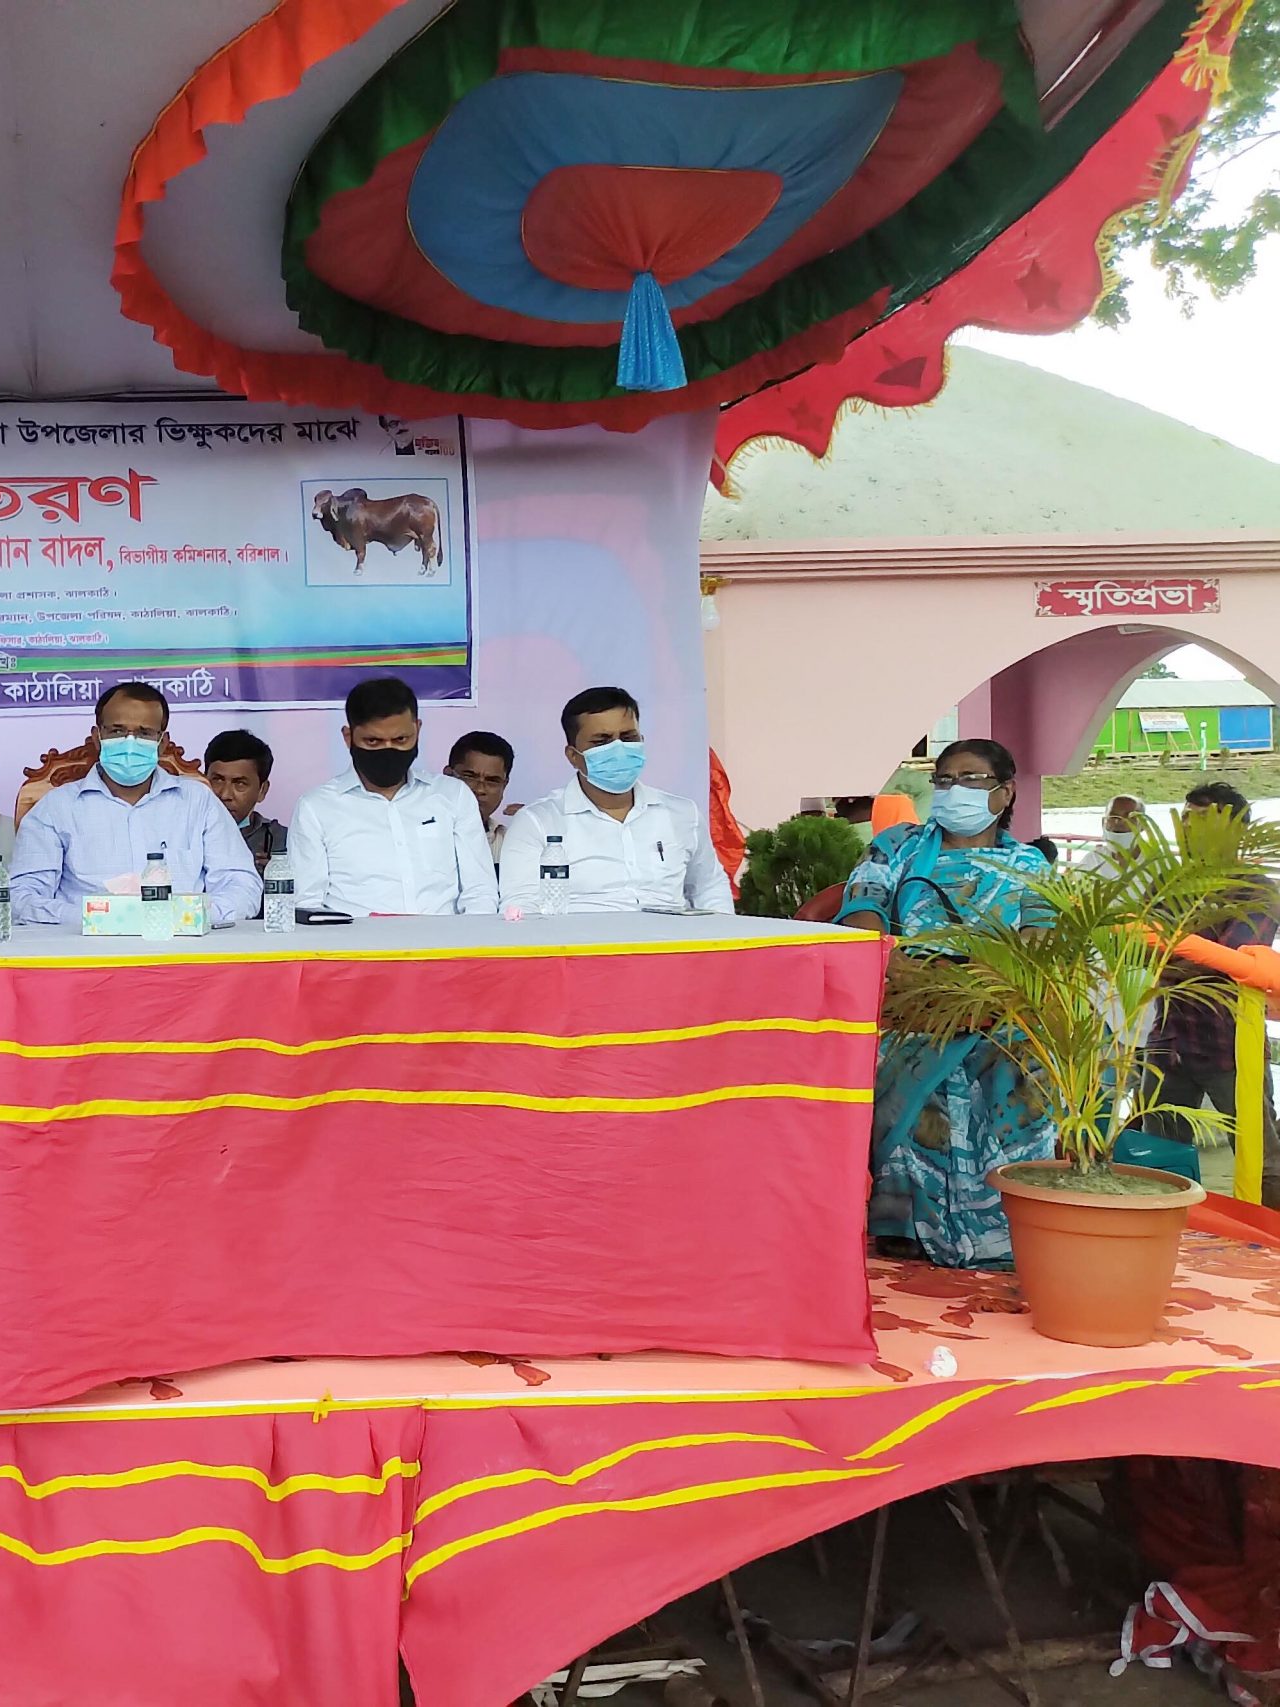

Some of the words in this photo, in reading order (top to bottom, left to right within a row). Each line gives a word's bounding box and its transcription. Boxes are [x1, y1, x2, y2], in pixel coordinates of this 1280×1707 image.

[16, 417, 146, 445] উপজেলার
[154, 416, 284, 449] ভিক্ষুকদের
[292, 416, 360, 443] মাঝে
[39, 534, 114, 573] বাদল,
[119, 545, 168, 565] বিভাগীয়
[1059, 580, 1195, 615] স্মৃতিপ্রভা
[2, 672, 103, 704] কাঠালিয়া
